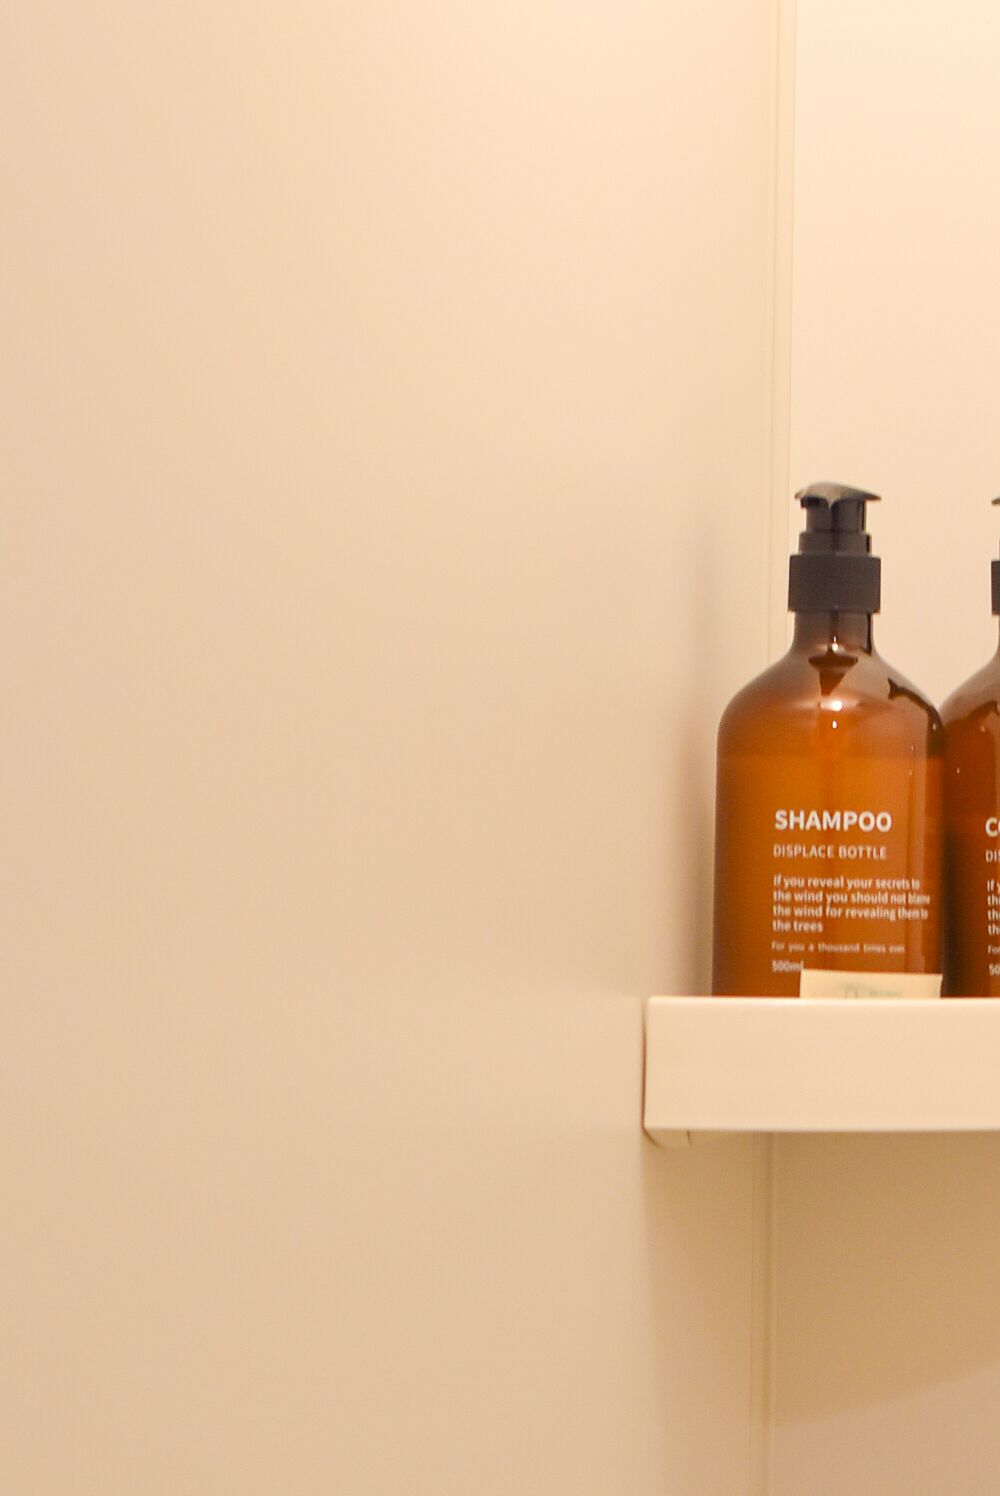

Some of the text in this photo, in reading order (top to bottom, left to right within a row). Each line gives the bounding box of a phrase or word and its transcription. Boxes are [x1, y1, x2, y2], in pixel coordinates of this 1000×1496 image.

[775, 810, 892, 832] SHAMPOO
[773, 844, 886, 860] DISPLACE BOTTLE
[774, 874, 920, 890] If you reveal your secrets to
[987, 879, 994, 891] If
[773, 890, 791, 902] the
[794, 890, 822, 902] wind
[826, 893, 848, 906] you
[851, 892, 888, 904] should
[890, 893, 906, 905] not
[773, 905, 791, 916] the
[794, 906, 822, 917] wind
[826, 906, 842, 918] for
[845, 907, 896, 922] revealing
[898, 907, 919, 920] them
[773, 920, 823, 932] the trees
[772, 941, 784, 951] For
[788, 944, 804, 955] you
[818, 942, 859, 953] thousand
[988, 945, 1000, 955] For
